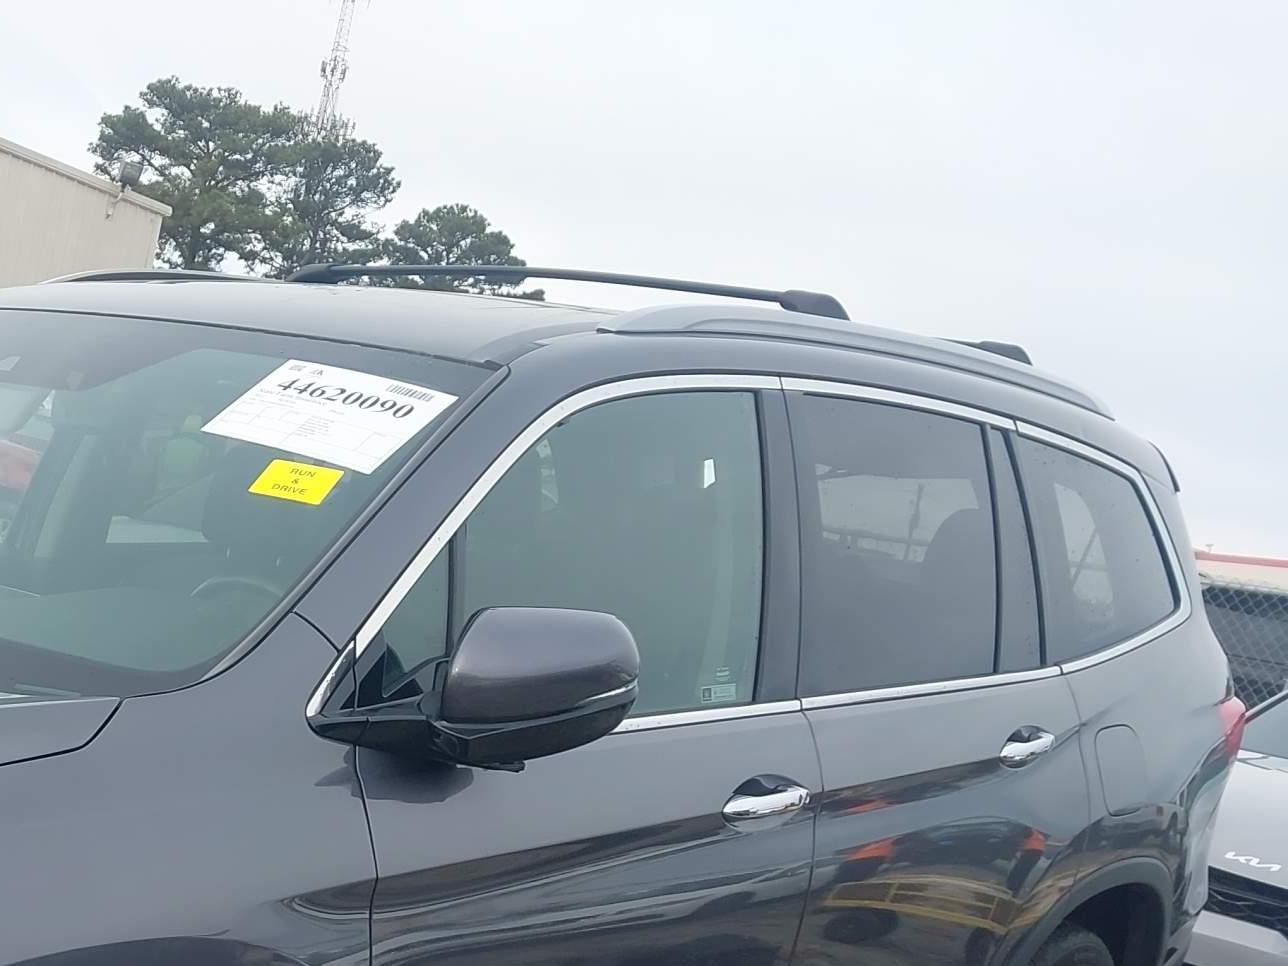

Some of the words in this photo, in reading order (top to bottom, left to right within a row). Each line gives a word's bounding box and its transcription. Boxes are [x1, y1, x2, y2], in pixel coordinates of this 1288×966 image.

[276, 378, 415, 419] 44620090
[289, 467, 317, 478] RUN
[271, 483, 309, 496] DRIVE
